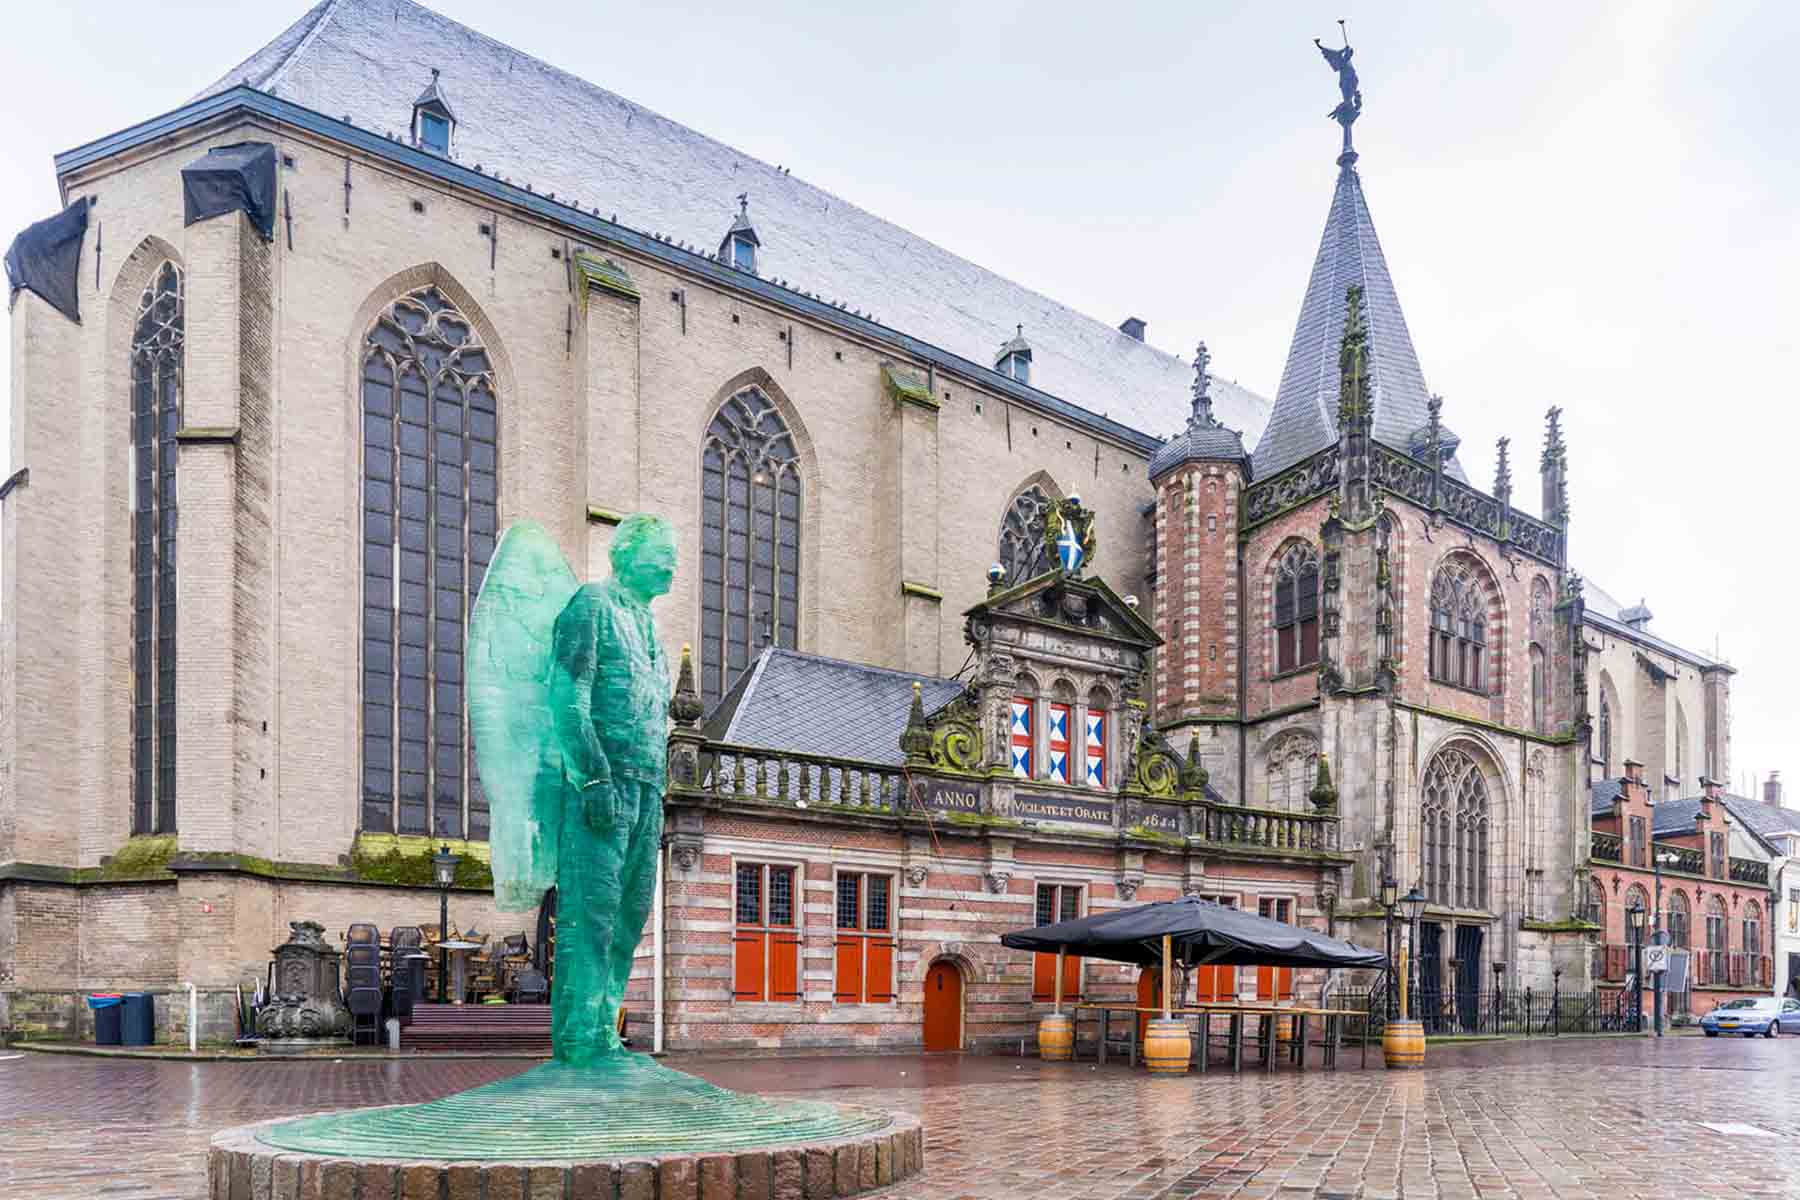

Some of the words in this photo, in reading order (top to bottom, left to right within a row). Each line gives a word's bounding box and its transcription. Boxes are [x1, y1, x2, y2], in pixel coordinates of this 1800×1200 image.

[934, 791, 976, 808] ANNO
[1059, 807, 1074, 817] ET
[1074, 807, 1110, 820] ORATE
